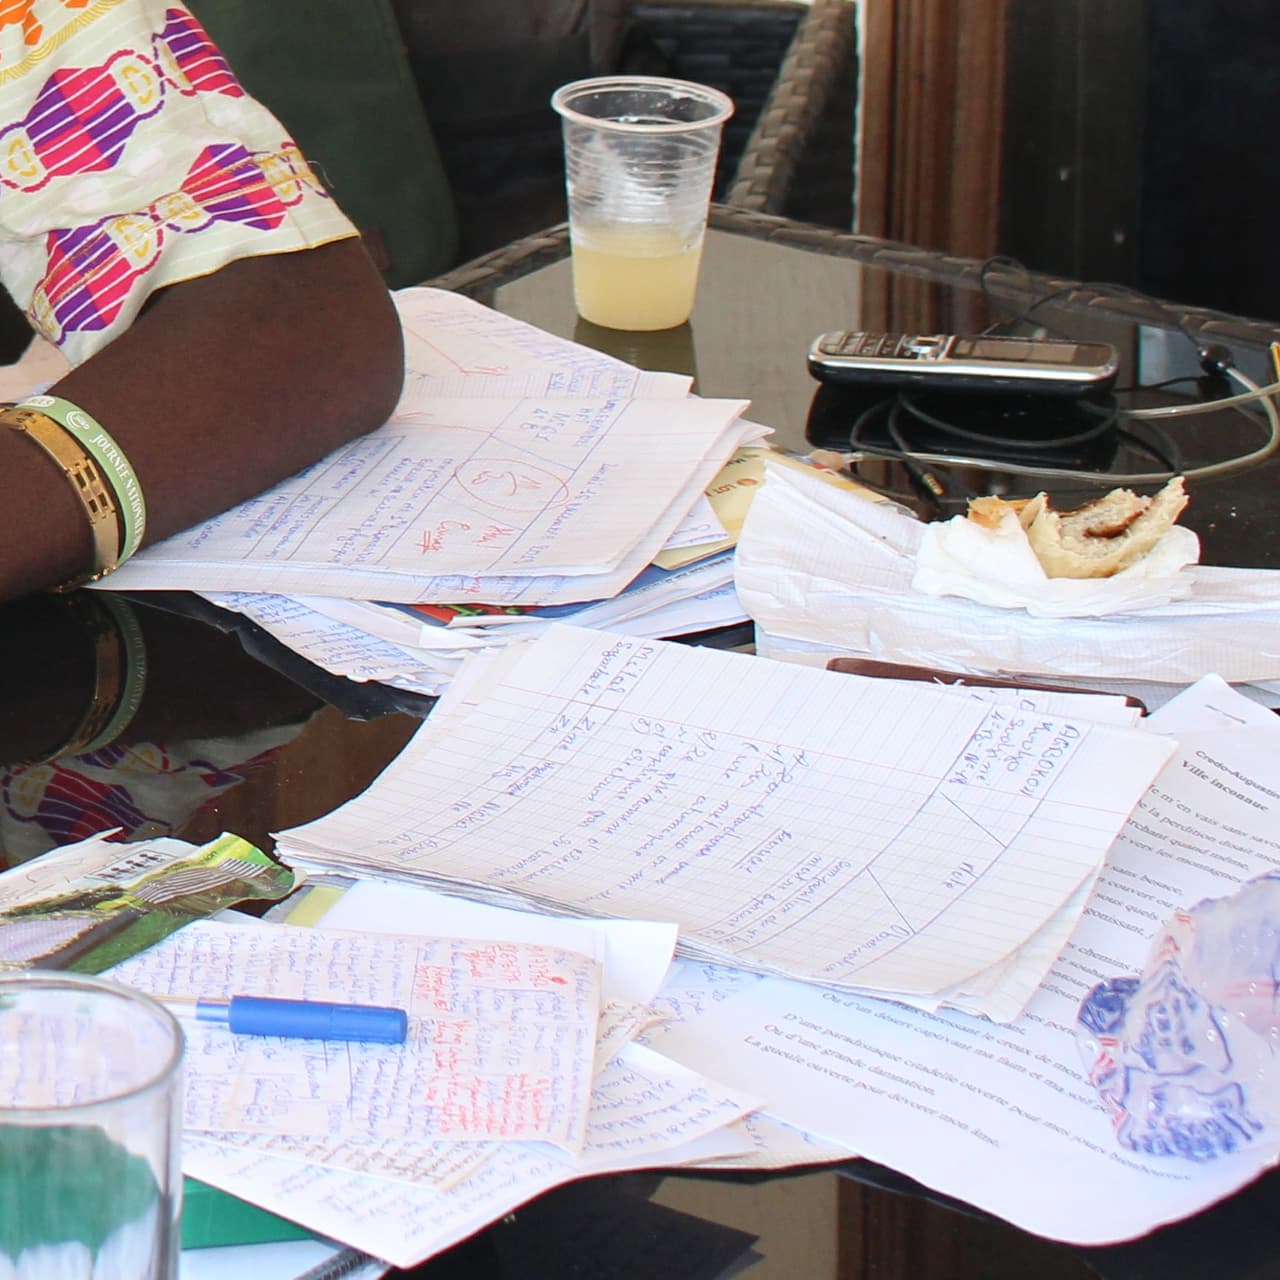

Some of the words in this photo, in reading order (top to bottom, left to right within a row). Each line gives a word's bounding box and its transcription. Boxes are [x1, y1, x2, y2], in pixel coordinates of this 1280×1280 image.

[89, 434, 130, 481] JOURNÉE
[1182, 760, 1209, 781] Ville
[1210, 779, 1269, 812] inconnue
